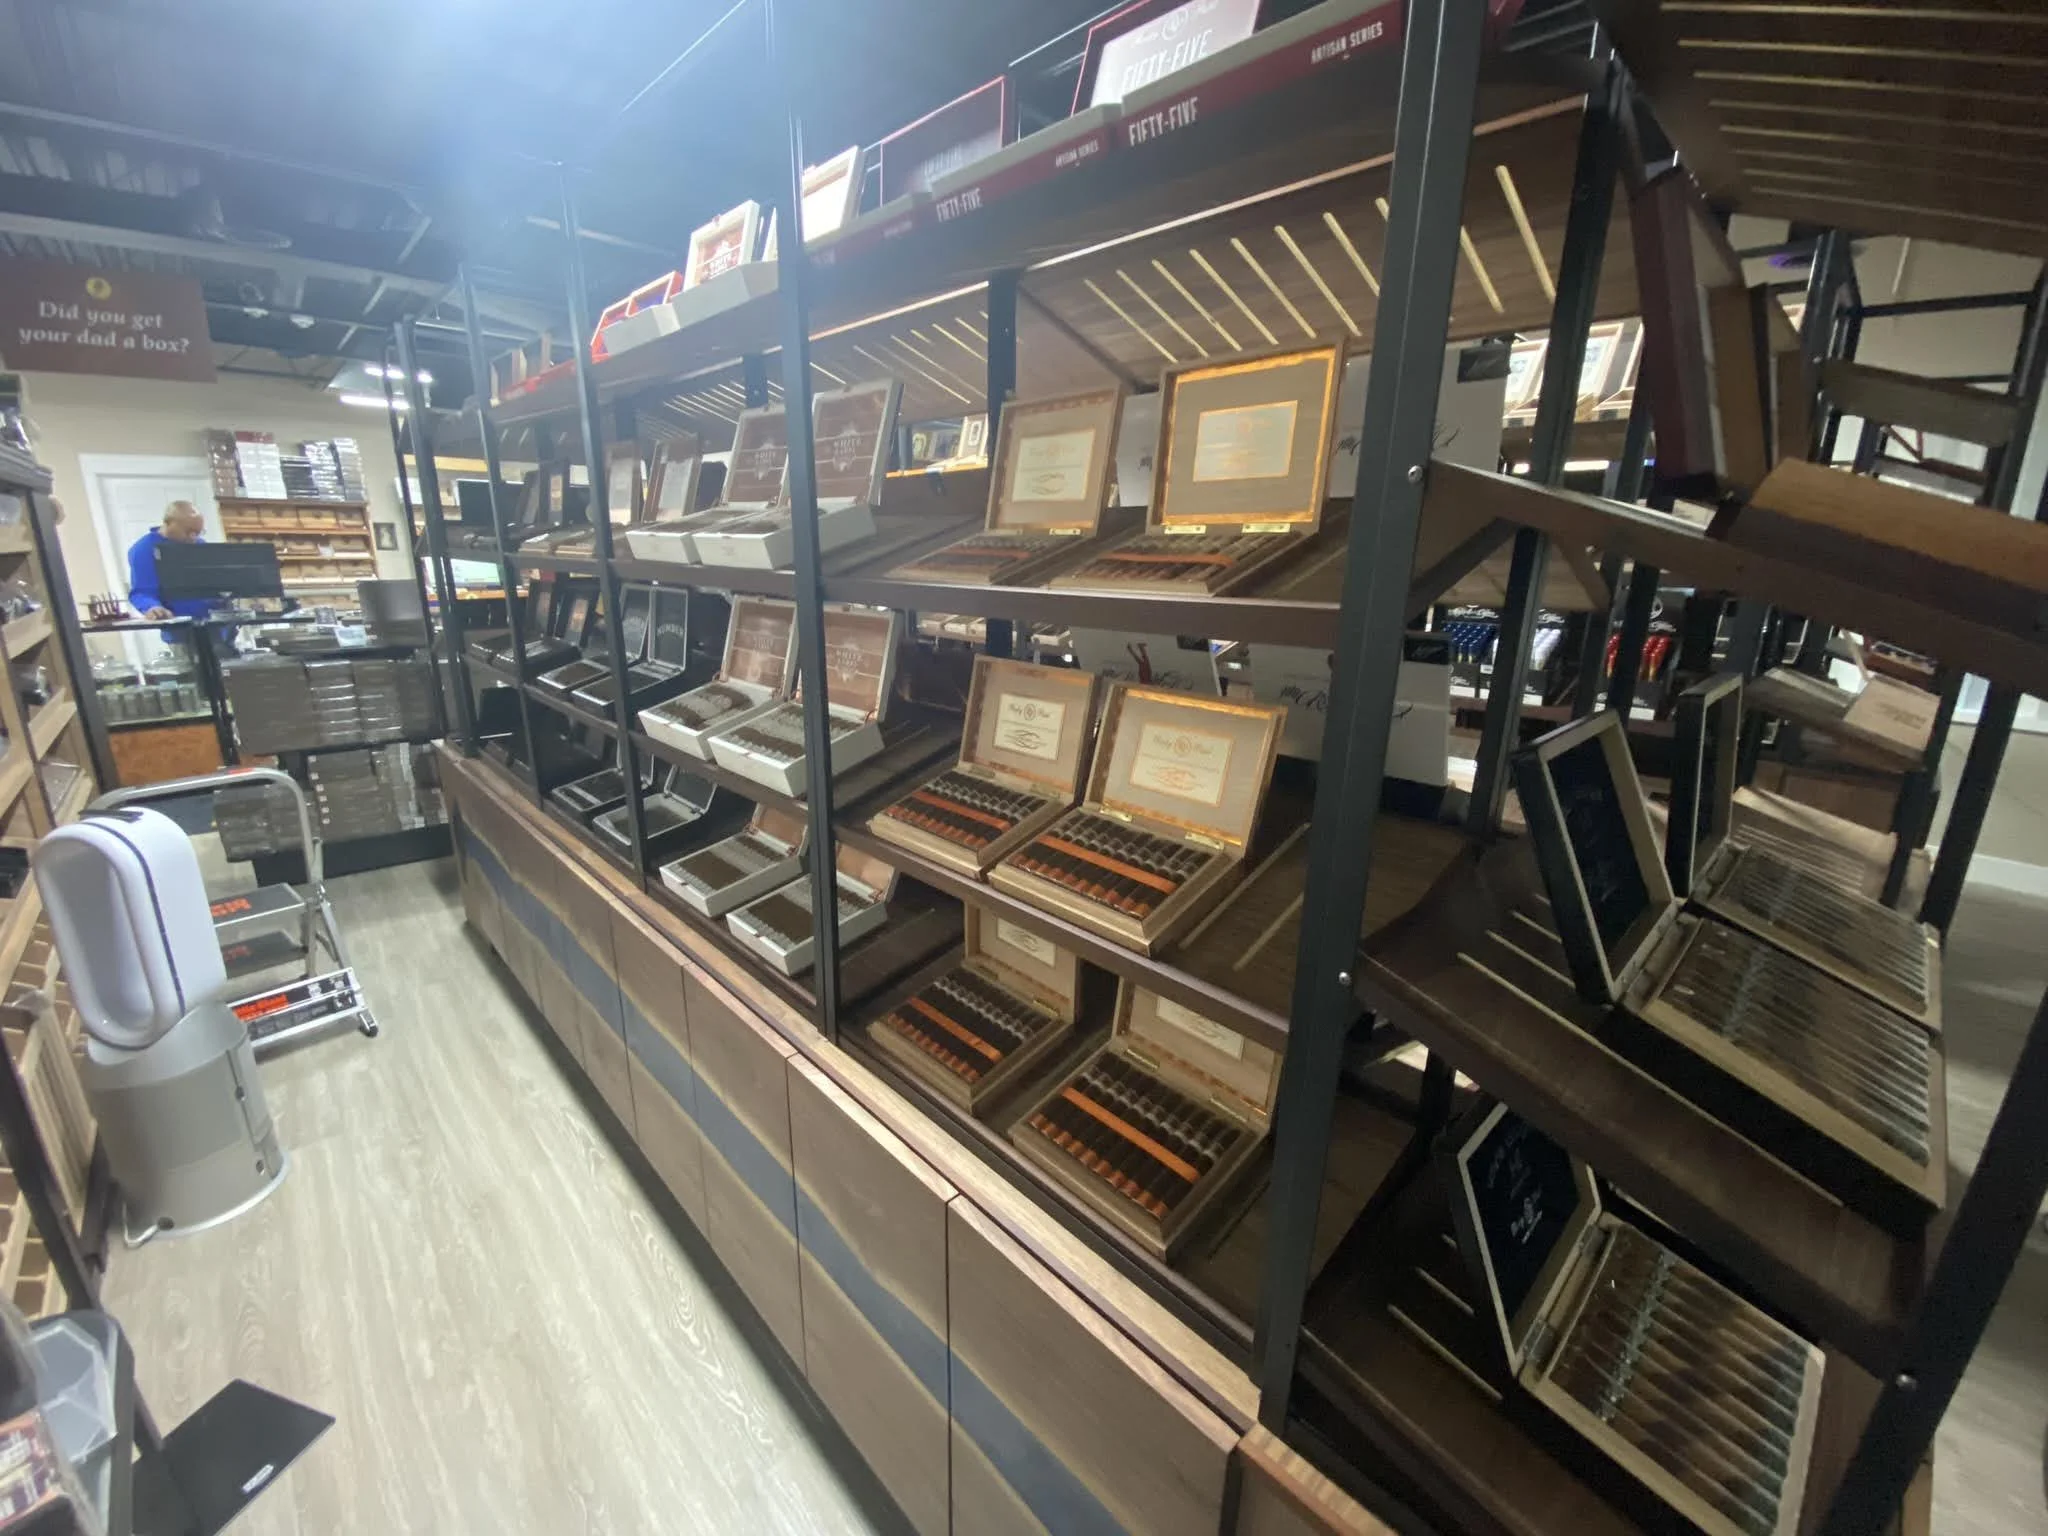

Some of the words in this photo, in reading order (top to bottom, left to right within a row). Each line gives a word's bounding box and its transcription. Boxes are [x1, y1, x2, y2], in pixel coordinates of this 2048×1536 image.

[1311, 35, 1347, 64] ARTISAN
[1350, 21, 1383, 48] SERIES
[1128, 97, 1199, 146] FIFTY-FIVE
[936, 187, 984, 222] FIFTY-FIVE
[39, 301, 80, 320] Did
[86, 308, 126, 326] you
[131, 313, 164, 330] get
[18, 327, 72, 344] your
[76, 329, 117, 347] dad
[123, 336, 135, 348] a
[143, 334, 190, 353] box?
